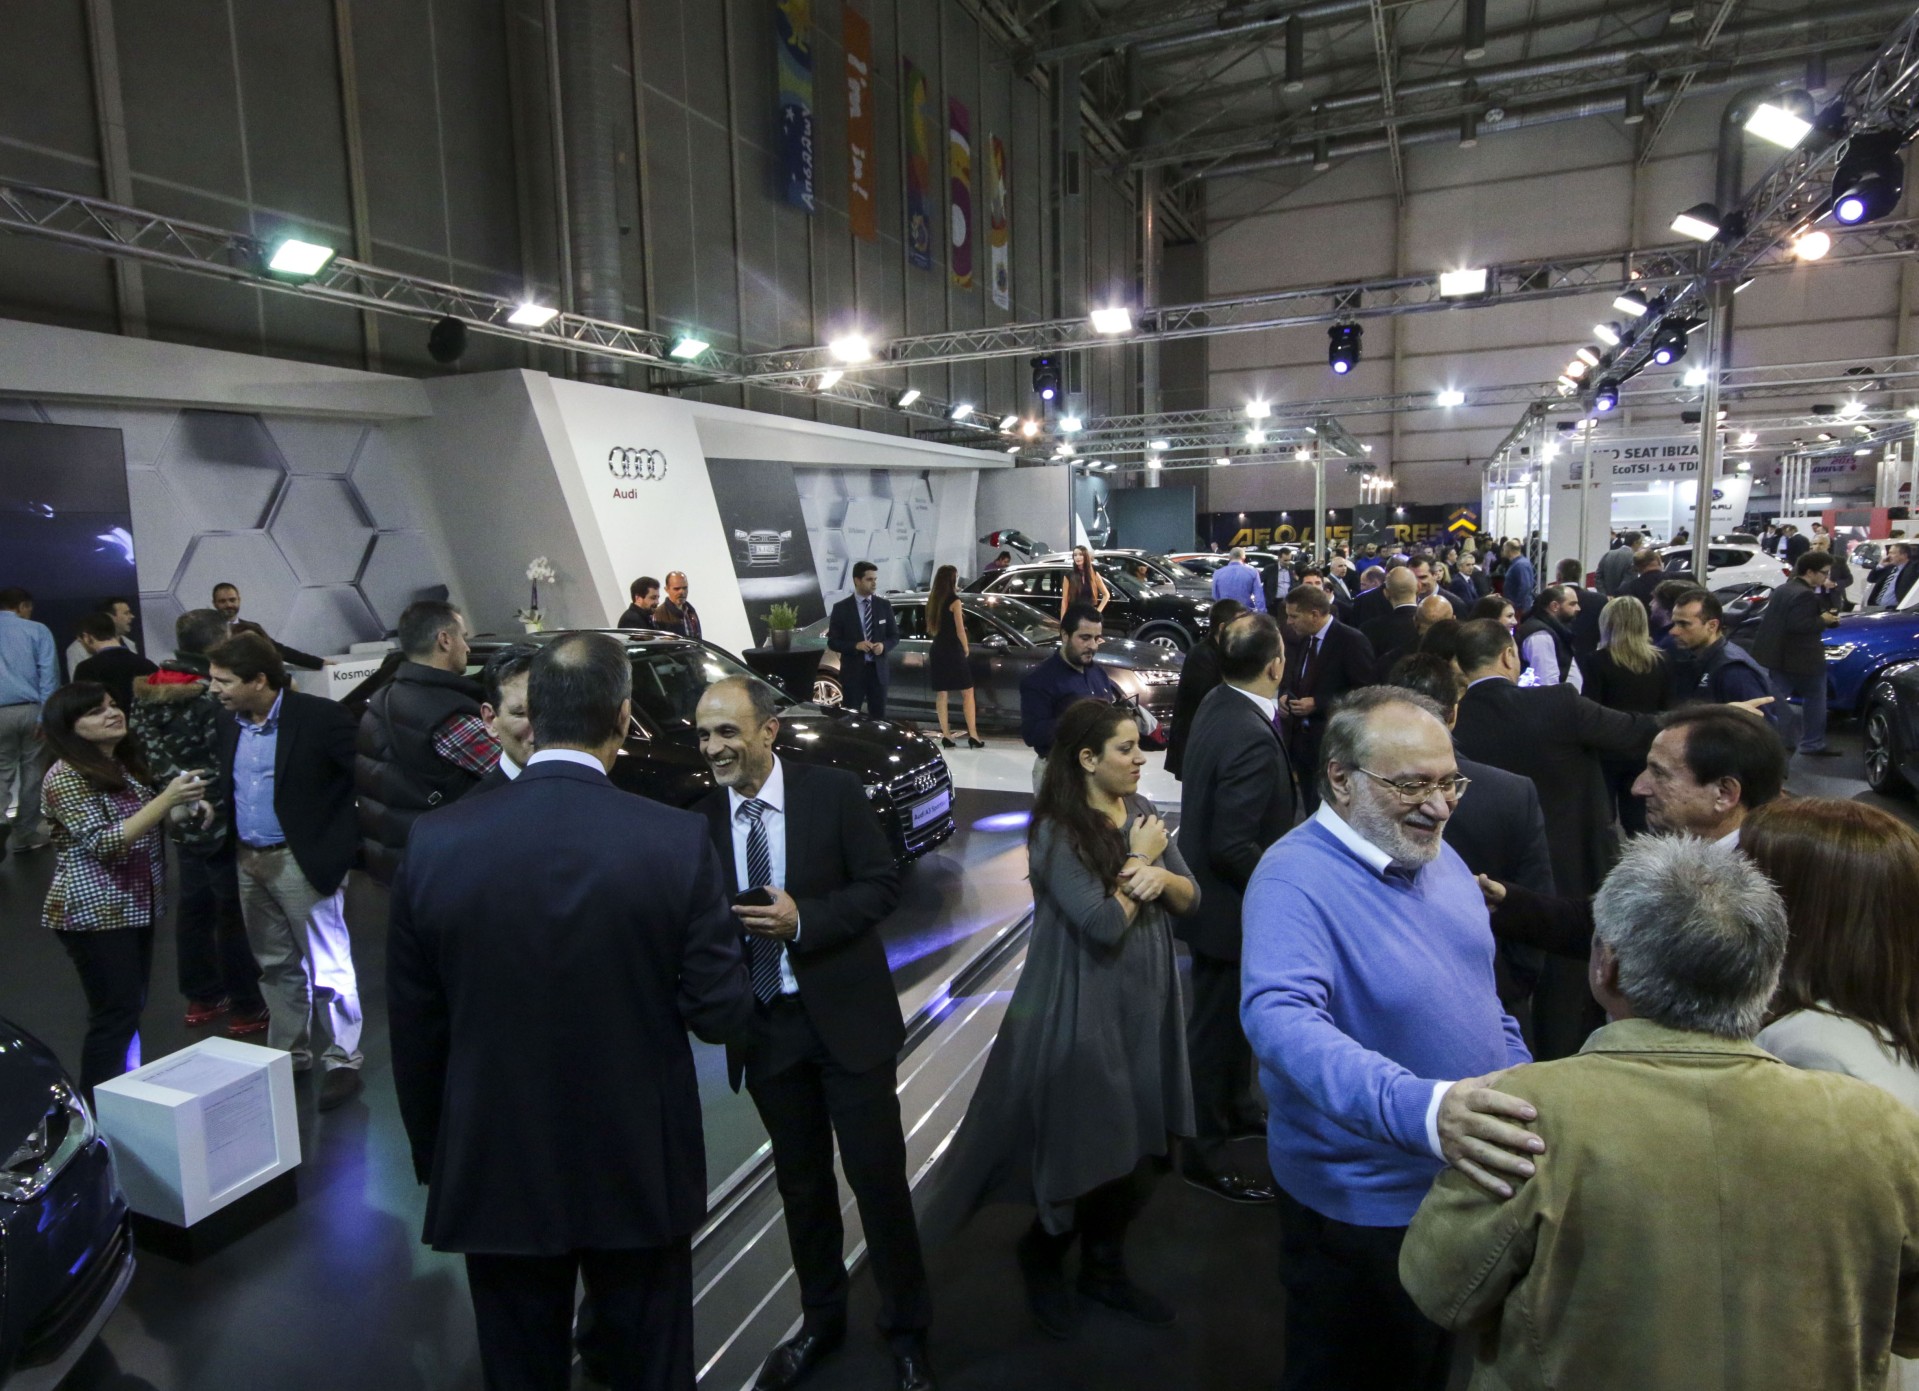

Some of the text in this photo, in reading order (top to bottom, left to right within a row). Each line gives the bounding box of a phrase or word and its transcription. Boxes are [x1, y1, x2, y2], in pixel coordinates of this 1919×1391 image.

[1624, 447, 1659, 459] SEAT
[1662, 445, 1699, 457] IBIZA
[1612, 463, 1650, 475] EcoTSI
[1659, 463, 1676, 473] 1.4
[1679, 461, 1699, 472] TDI
[1561, 482, 1601, 490] SET
[612, 488, 638, 499] Audi
